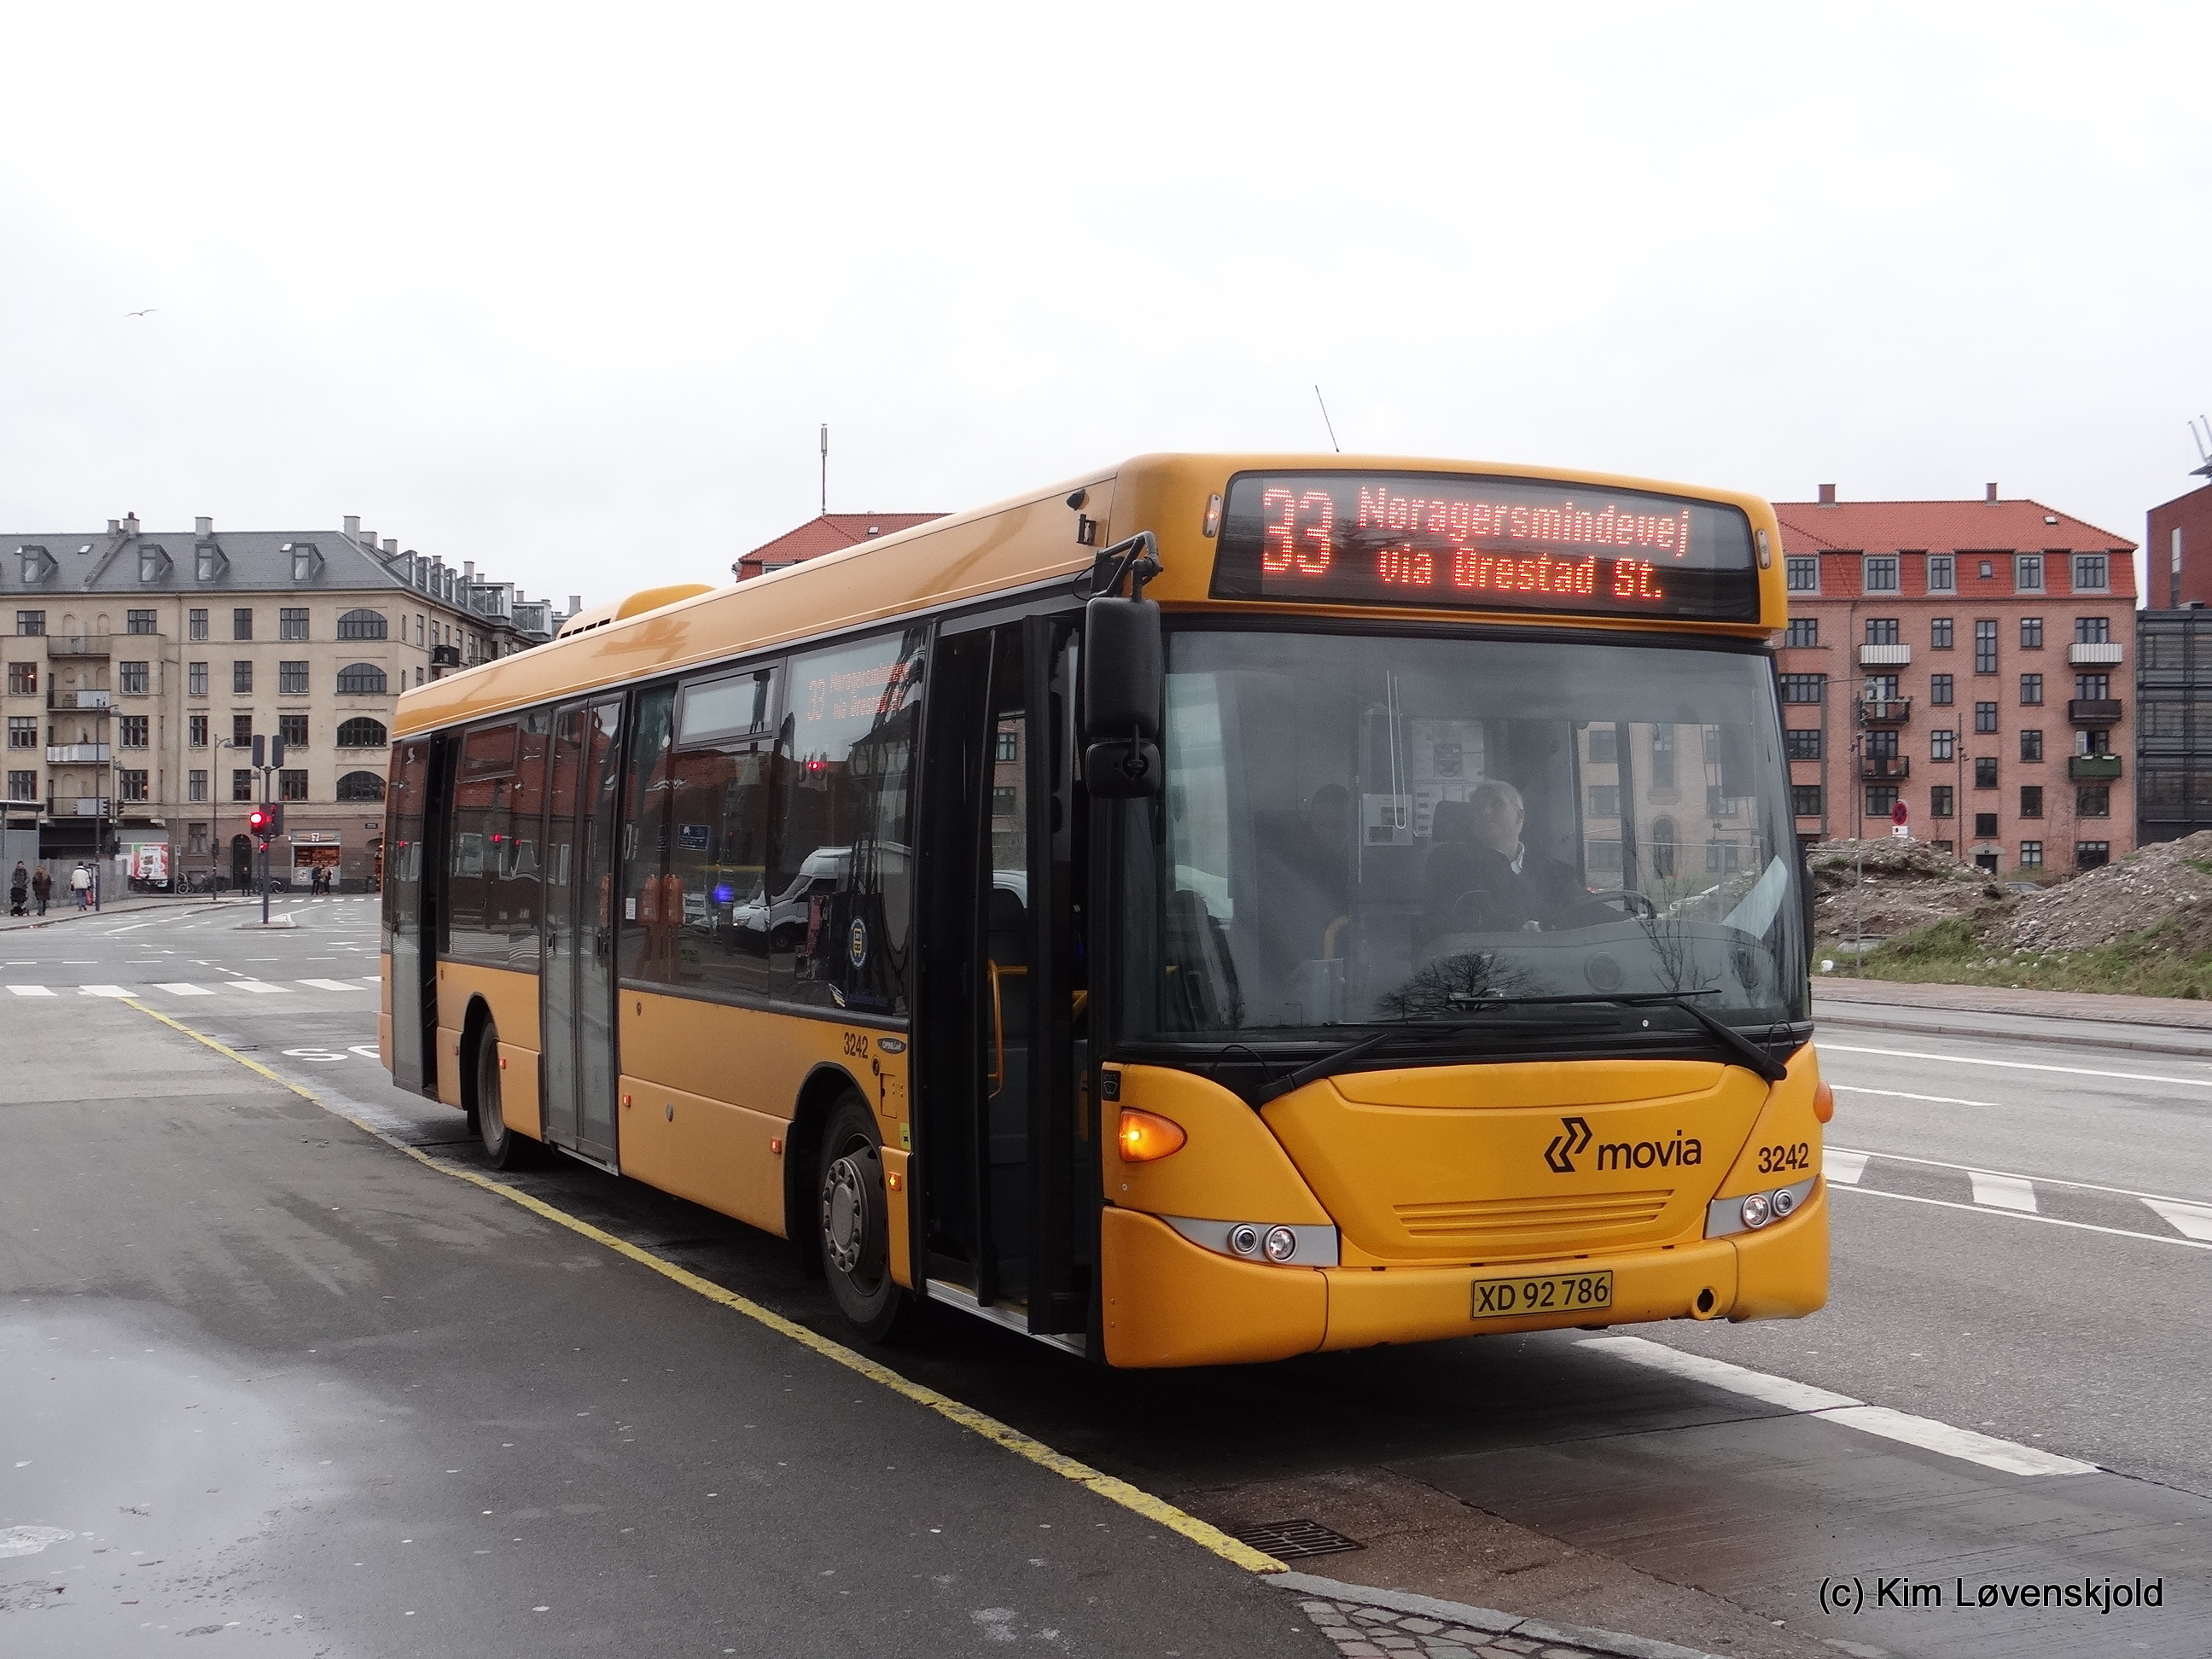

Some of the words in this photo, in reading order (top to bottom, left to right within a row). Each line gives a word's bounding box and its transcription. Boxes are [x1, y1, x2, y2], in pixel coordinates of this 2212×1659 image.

[1264, 488, 1333, 573] 33
[1359, 486, 1688, 557] Nøragersmindevej
[1378, 543, 1432, 584] via
[1454, 546, 1595, 594] Ørestad
[1614, 557, 1662, 598] St.
[843, 1032, 869, 1059] 3242
[1597, 1130, 1702, 1171] movia
[1758, 1142, 1809, 1174] 3242
[1478, 1285, 1516, 1312] XD
[1523, 1282, 1555, 1309] 92
[1561, 1277, 1608, 1305] 786
